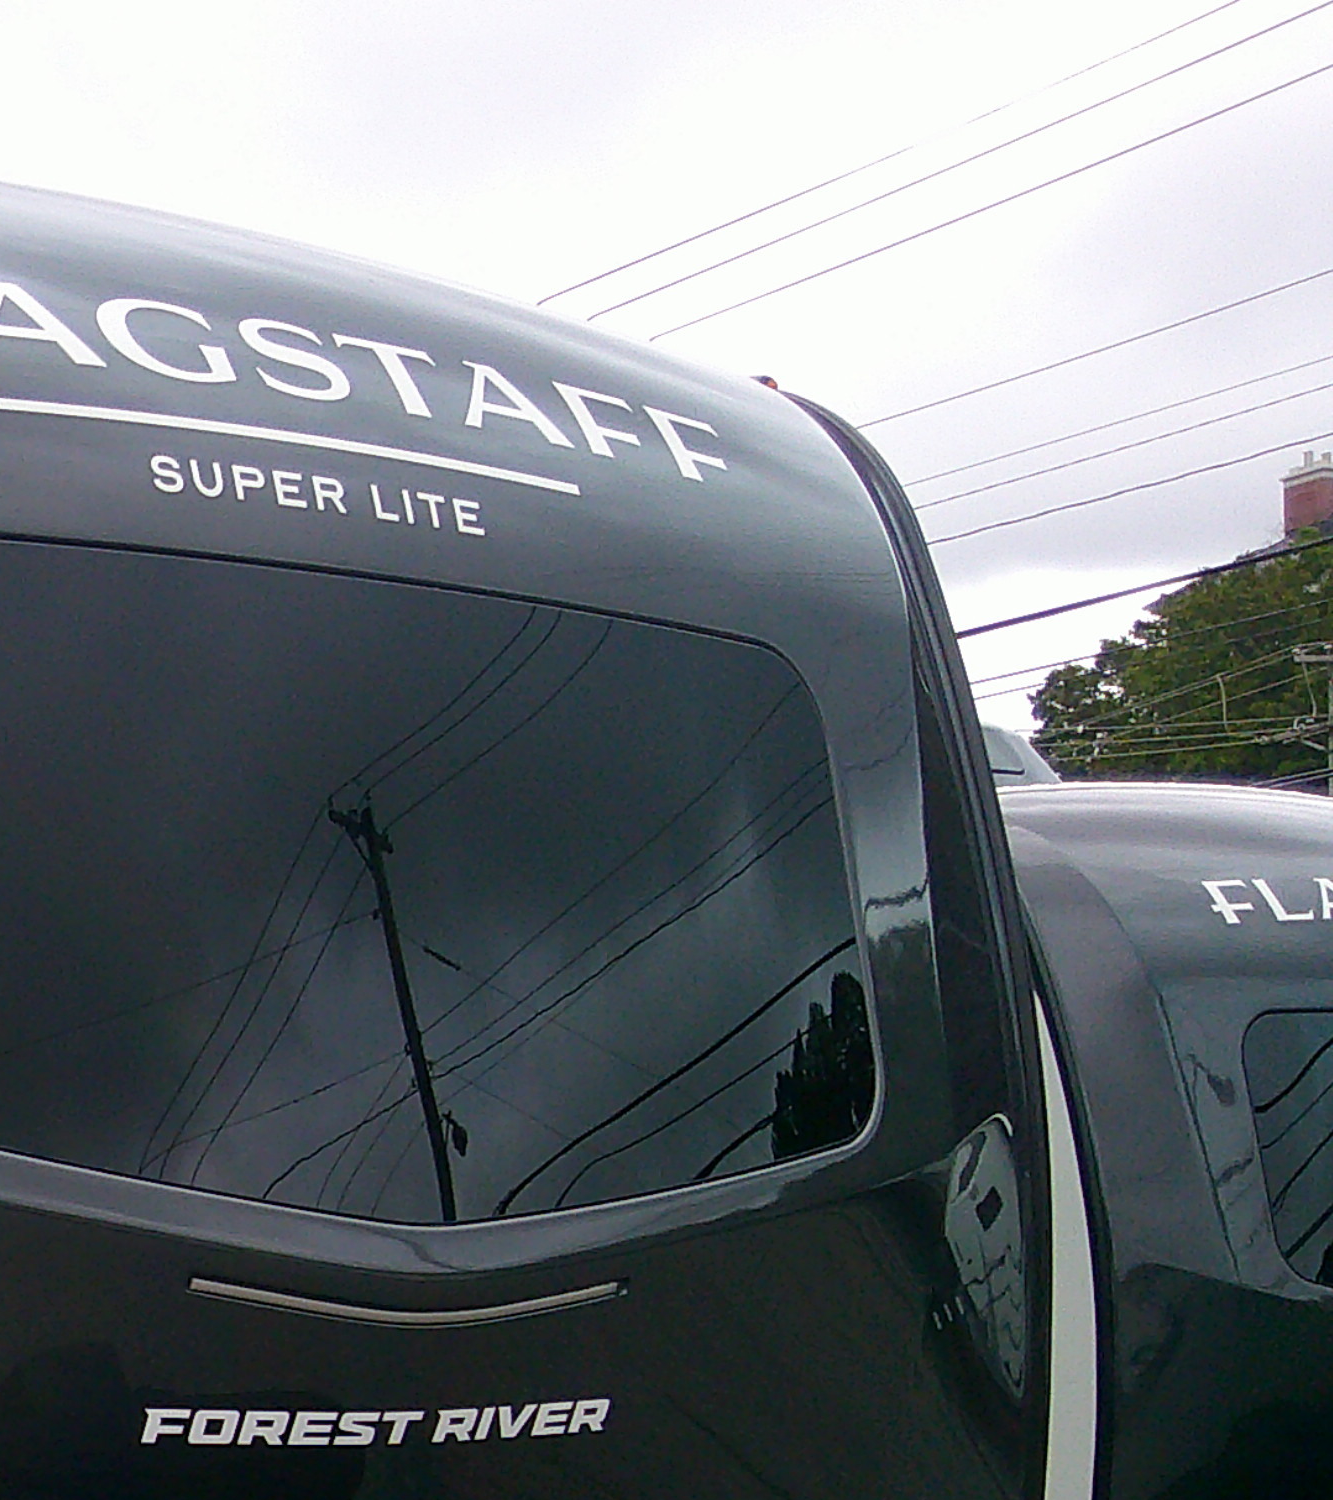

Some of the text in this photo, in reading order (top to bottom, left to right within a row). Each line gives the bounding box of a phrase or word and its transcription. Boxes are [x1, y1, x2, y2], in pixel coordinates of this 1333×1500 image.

[149, 454, 487, 537] SUPER LITE
[140, 1398, 610, 1446] FOREST RIVER
